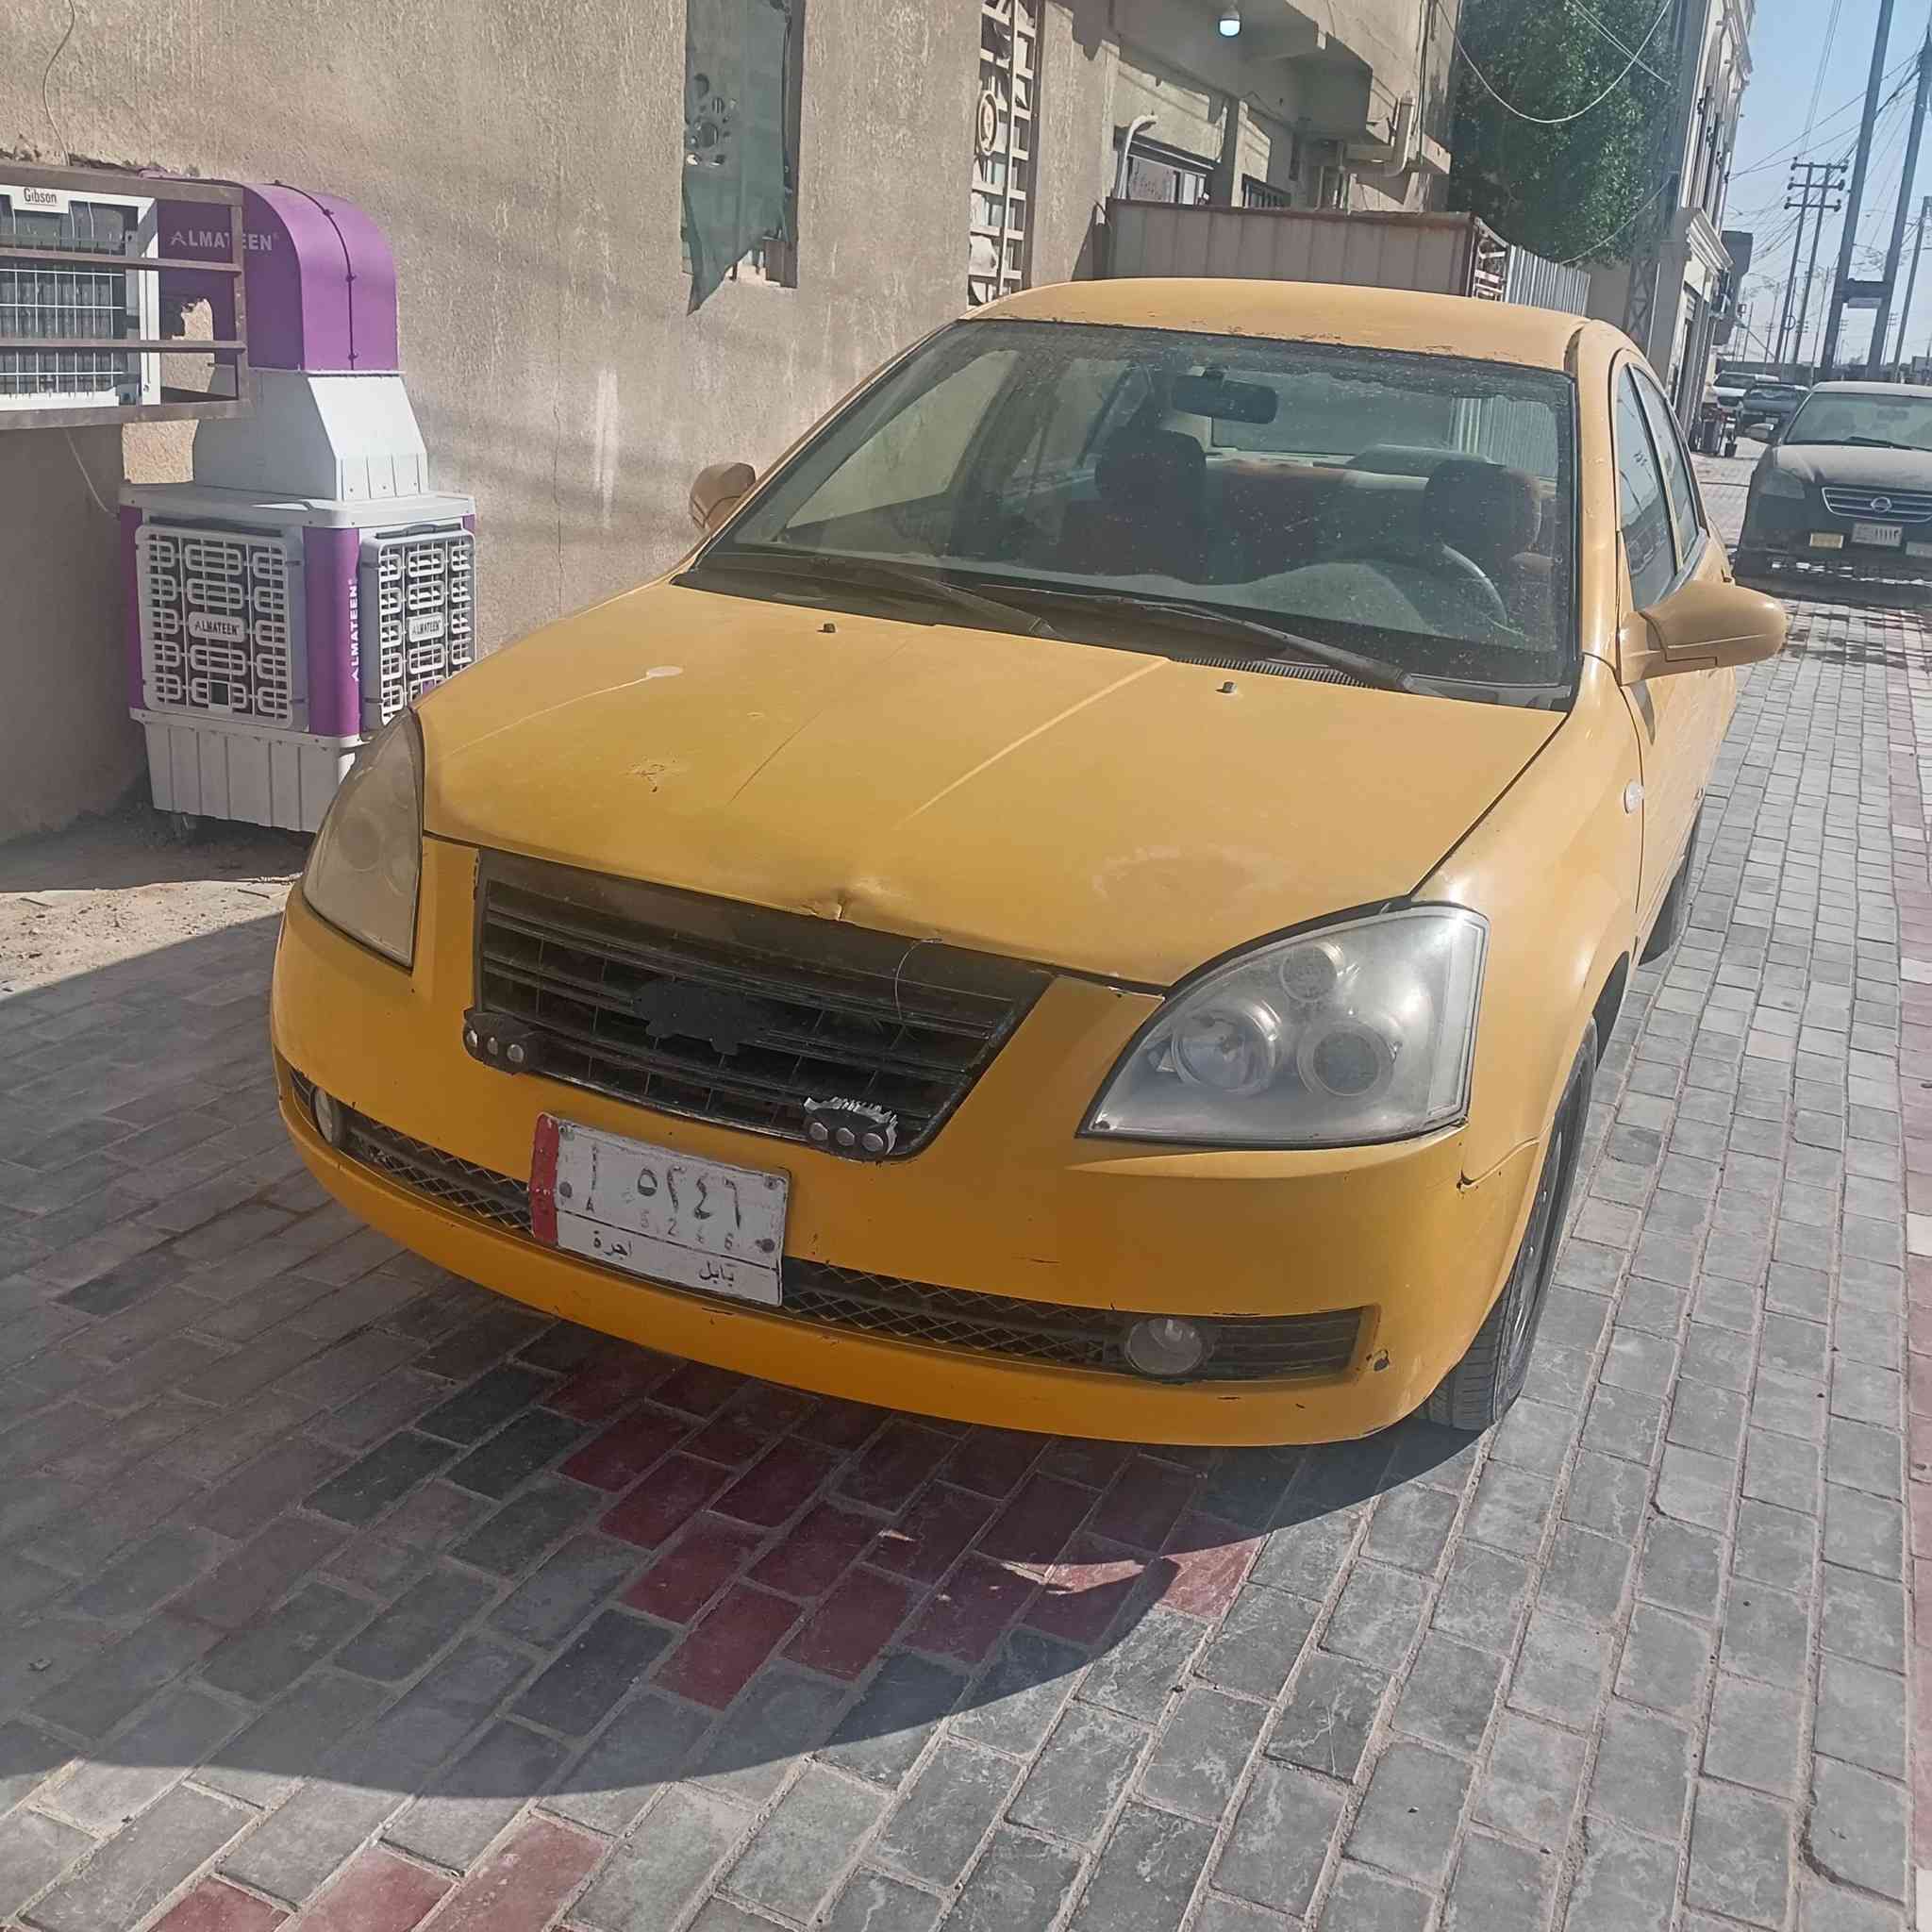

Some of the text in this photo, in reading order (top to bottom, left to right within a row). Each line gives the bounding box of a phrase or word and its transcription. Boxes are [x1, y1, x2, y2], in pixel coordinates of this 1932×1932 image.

[24, 188, 57, 204] Gibson
[171, 230, 273, 251] ALMATEN
[194, 620, 241, 636] ALMATEEN
[349, 585, 359, 682] ALMATEEN
[637, 1165, 742, 1229] ٥٢٤٦
[699, 1260, 735, 1288] بابل
